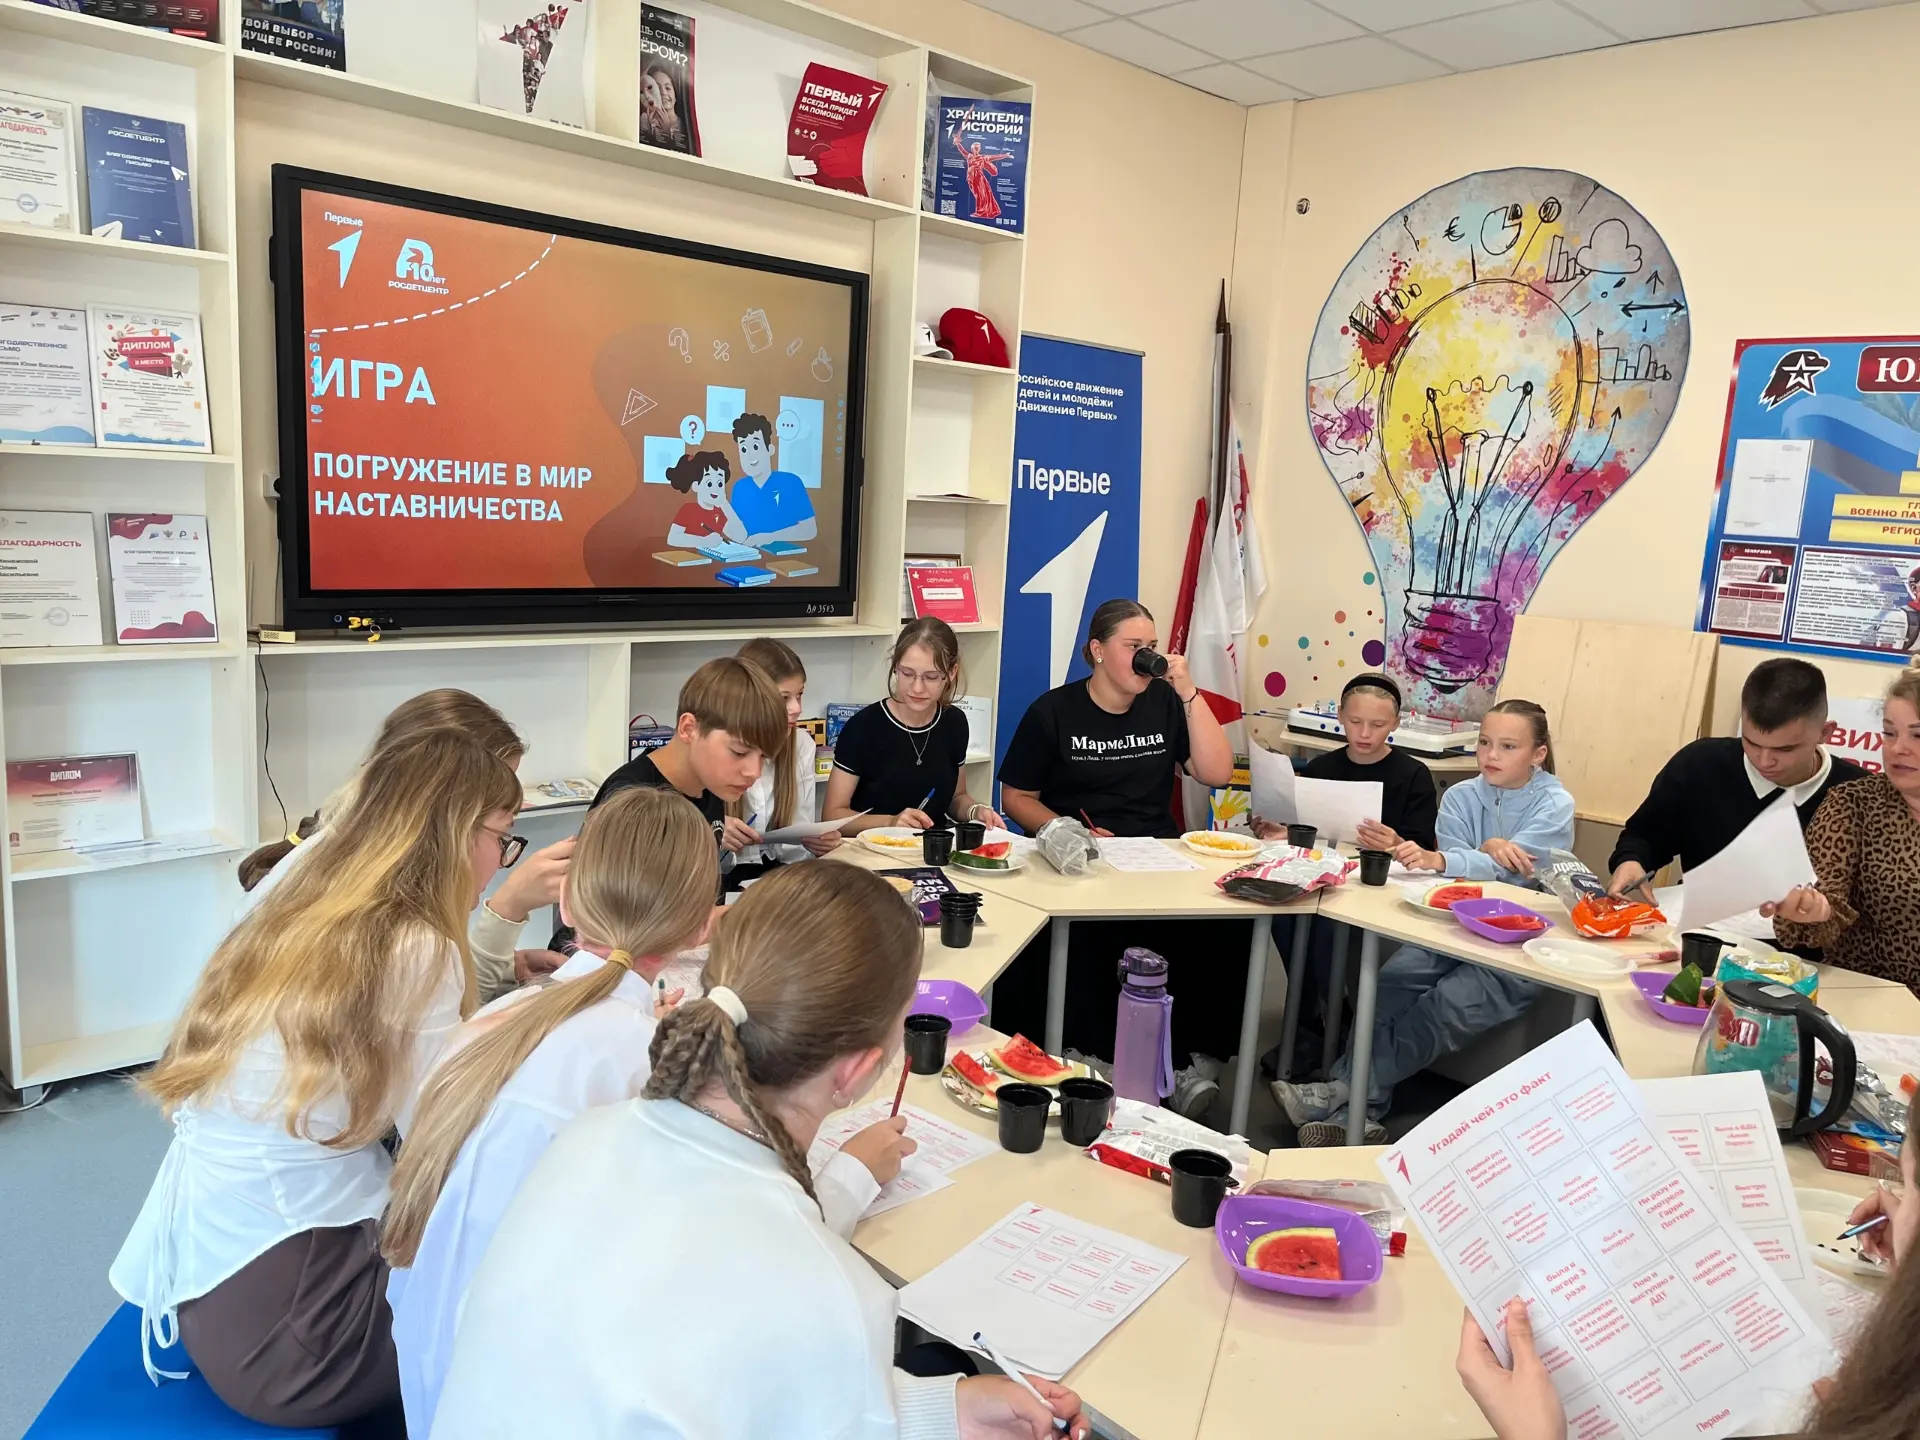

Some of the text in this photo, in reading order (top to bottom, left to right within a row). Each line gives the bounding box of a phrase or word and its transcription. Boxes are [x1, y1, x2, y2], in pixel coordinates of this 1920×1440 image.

[272, 24, 314, 40] ВЫБОР
[655, 29, 685, 48] СТАТЬ
[241, 30, 337, 59] ДУЩЕЕ РОССИИ!
[640, 37, 688, 67] ЁРОМ?
[805, 82, 863, 108] ПЕРВЫЙ
[799, 104, 809, 112] НА
[810, 107, 846, 121] ПОМОЩЬ!
[801, 96, 858, 117] ВСЕГДА ПРИДЕТ
[946, 108, 1024, 124] ХРАНИТЕЛИ
[0, 121, 48, 136] АГОДАРНОСТЬ
[961, 121, 1023, 135] ИСТОРИИ
[324, 211, 364, 227] Первые
[388, 280, 450, 295] РОСДЕТЦЕНТР
[0, 339, 68, 350] АГОДАРСТВЕННОЕ
[121, 341, 171, 352] ДИПЛОМ
[312, 355, 436, 406] ИГРА
[1017, 374, 1124, 397] оссийское движение
[1019, 388, 1114, 408] детей и молодёжи
[1076, 407, 1117, 420] Первых»
[313, 452, 592, 489] ПОГРУЖЕНИЕ В МИР
[1018, 459, 1111, 501] Первые
[314, 490, 563, 522] НАСТАВНИЧЕСТВА
[1850, 508, 1897, 518] ВОЕННО
[1071, 733, 1165, 754] МармеЛида
[1428, 1072, 1551, 1156] Угадай чей это факт
[1465, 1149, 1503, 1176] Первый раз
[1476, 1163, 1512, 1190] на рыбалке
[1638, 1180, 1680, 1206] Ни разу не
[1646, 1188, 1685, 1214] смотрела
[1658, 1201, 1684, 1219] Гарри
[1660, 1208, 1695, 1230] Поттера
[1601, 1232, 1636, 1255] Беларуси
[1695, 1250, 1722, 1270] делаю
[1546, 1262, 1577, 1282] была в
[1692, 1259, 1728, 1283] поделки
[1706, 1266, 1737, 1286] бисера
[1550, 1268, 1587, 1296] лагере 3
[1629, 1278, 1669, 1305] выступаю
[1632, 1276, 1652, 1289] Пою
[1564, 1284, 1587, 1302] раза
[1650, 1291, 1667, 1307] ДДТ
[1696, 1408, 1731, 1433] Первые
